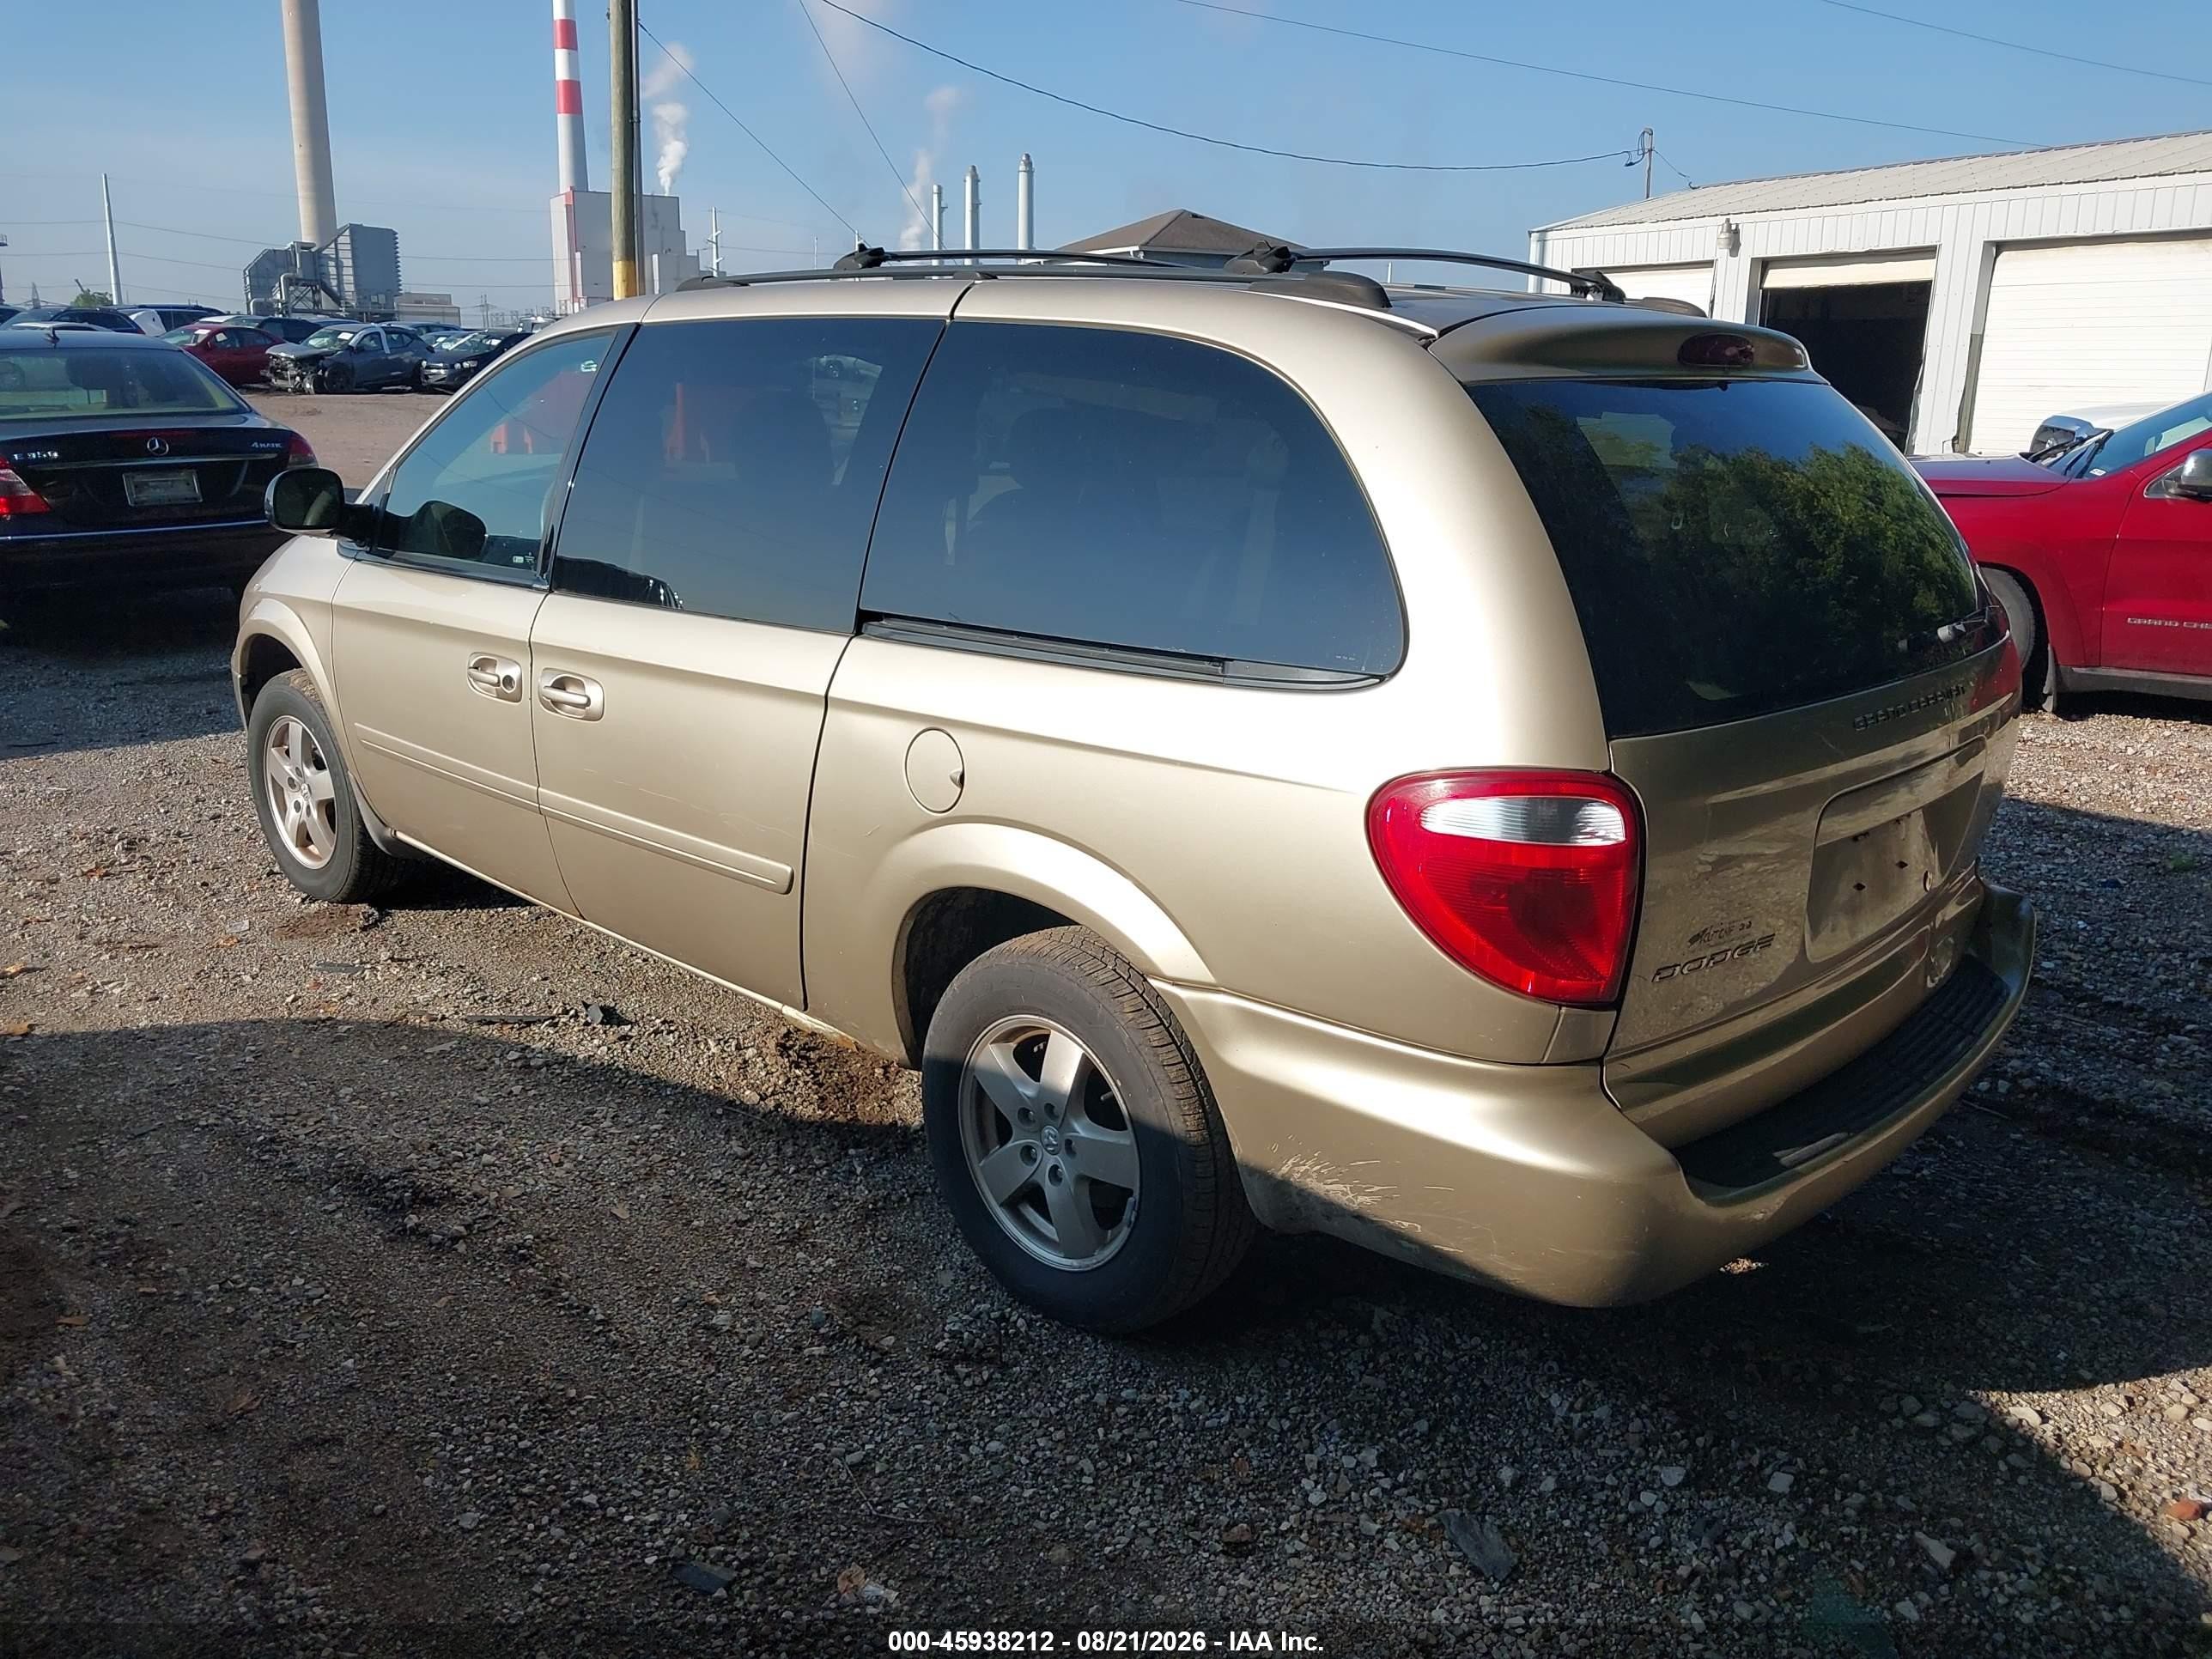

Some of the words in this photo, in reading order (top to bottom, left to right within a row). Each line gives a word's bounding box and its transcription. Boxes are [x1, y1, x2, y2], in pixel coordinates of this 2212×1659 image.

[2127, 617, 2180, 627] GRAND
[1854, 704, 1907, 732] GRAND
[1650, 933, 1777, 983] DODGE
